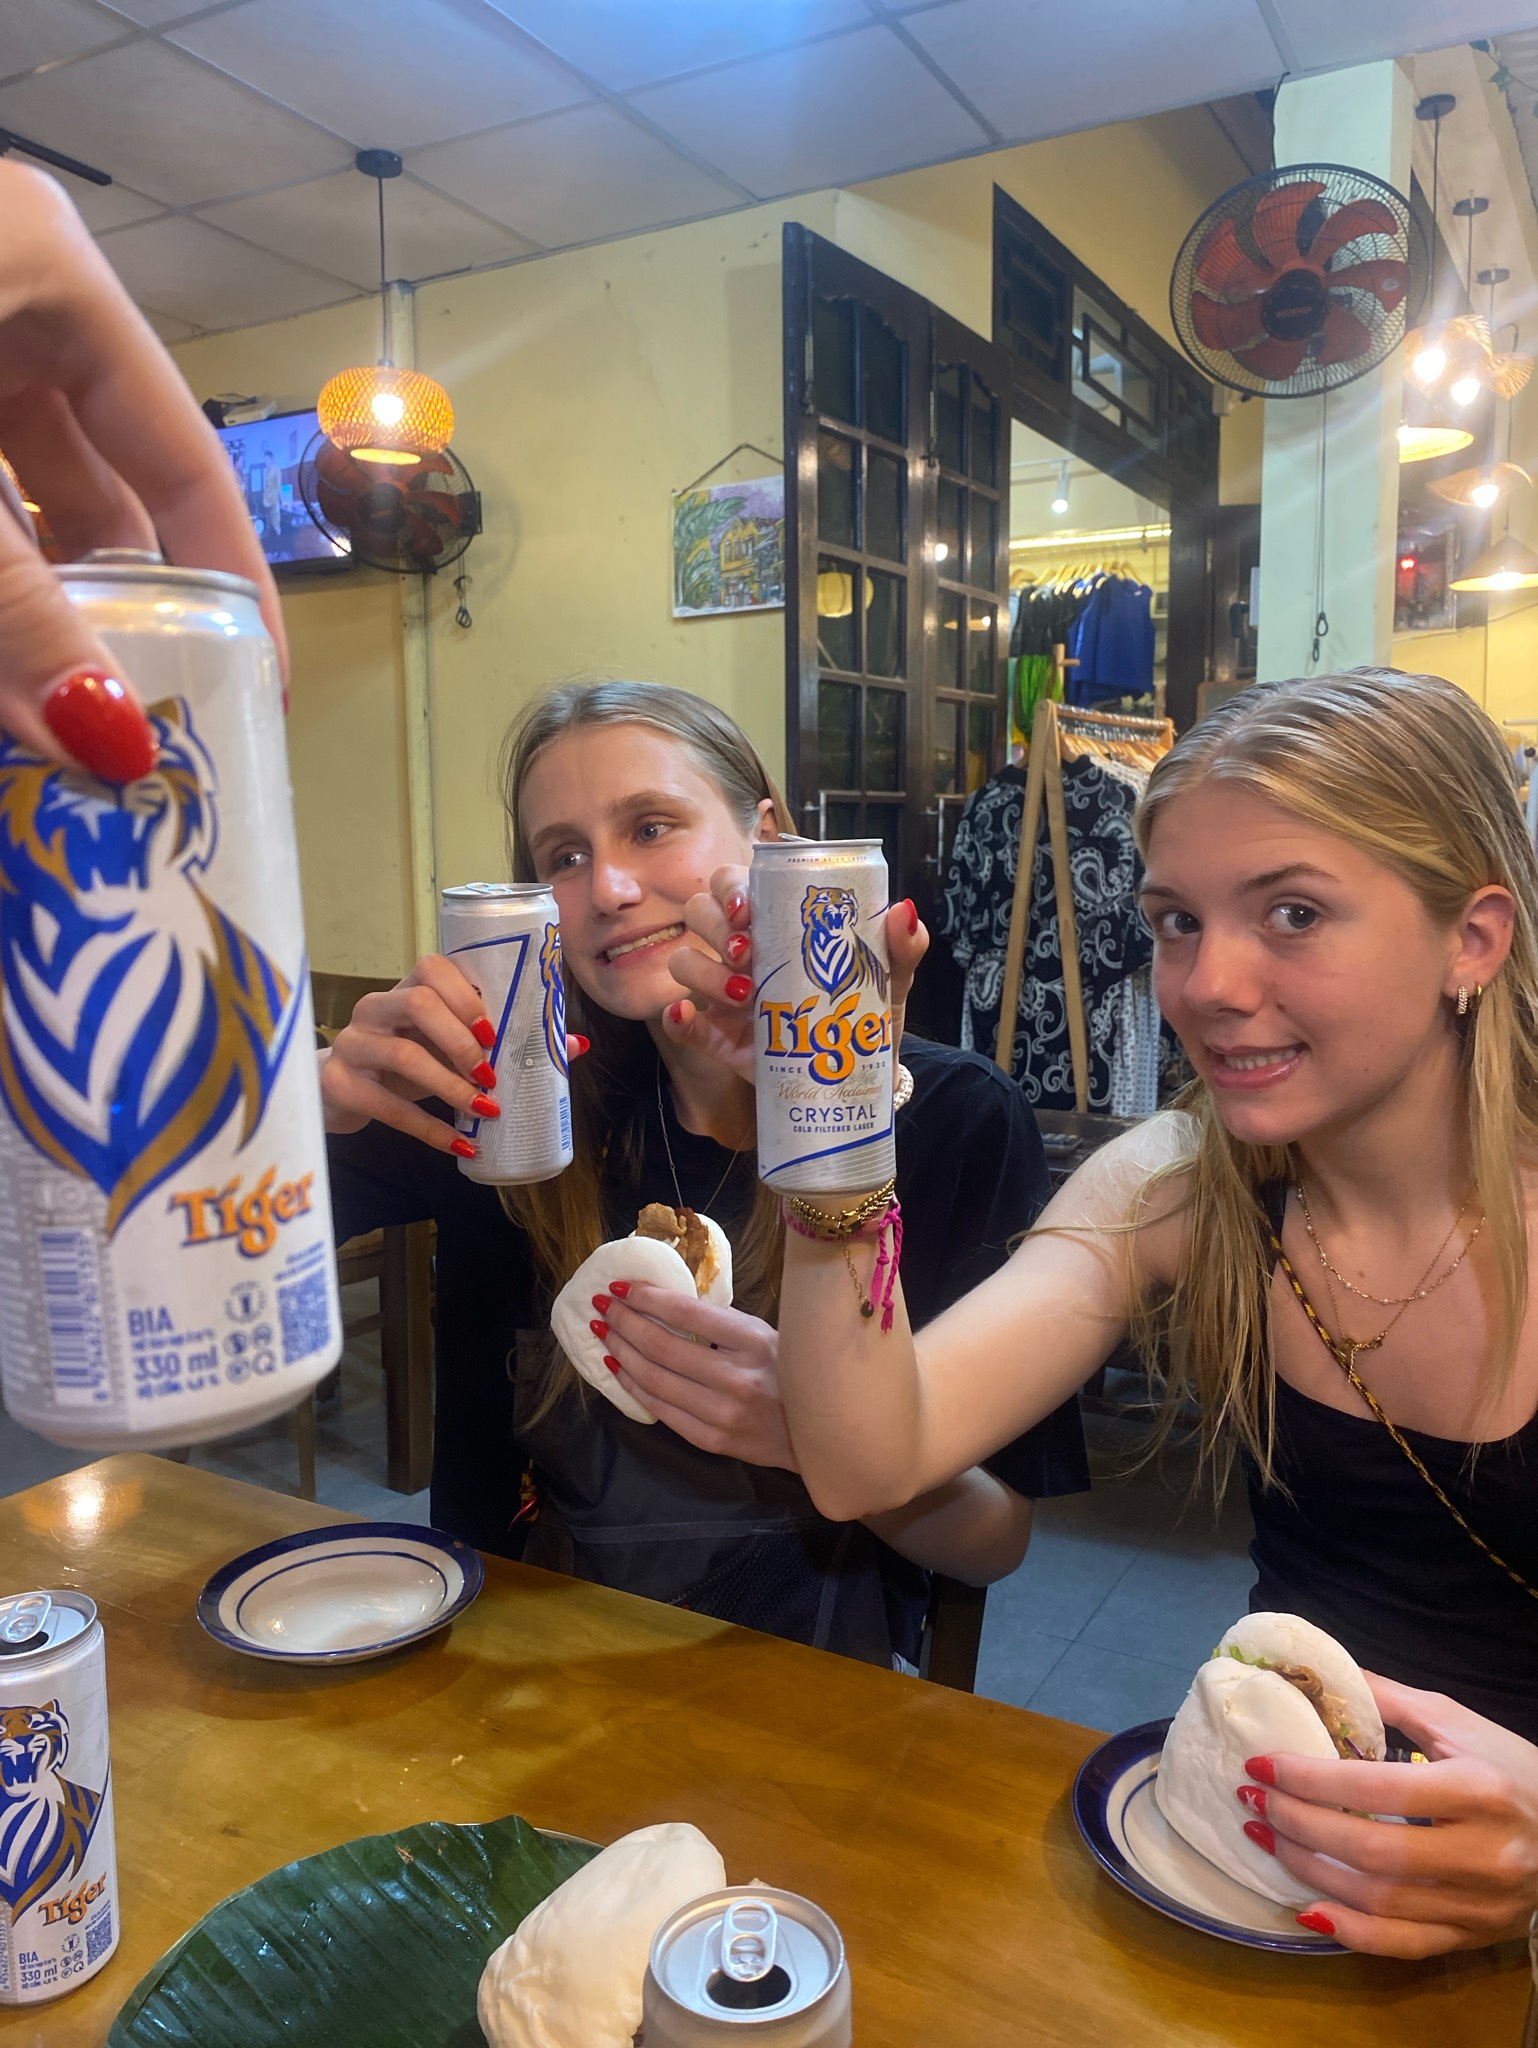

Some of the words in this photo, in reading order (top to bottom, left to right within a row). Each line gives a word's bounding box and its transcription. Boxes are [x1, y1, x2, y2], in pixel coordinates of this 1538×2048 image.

[759, 992, 892, 1086] Tiger
[769, 1065, 802, 1074] SINCE
[777, 1081, 819, 1099] World
[789, 1104, 877, 1123] CRYSTAL
[793, 1125, 812, 1133] COLD
[815, 1124, 851, 1133] FILTERED
[853, 1122, 874, 1131] LAGER
[167, 1165, 314, 1260] Tiger
[128, 1305, 174, 1337] BIA
[133, 1351, 181, 1382] 330
[188, 1344, 219, 1374] ml
[37, 1871, 107, 1926] Tiger
[18, 1951, 39, 1965] BIA
[20, 1969, 41, 1983] 330
[44, 1965, 58, 1978] ml
